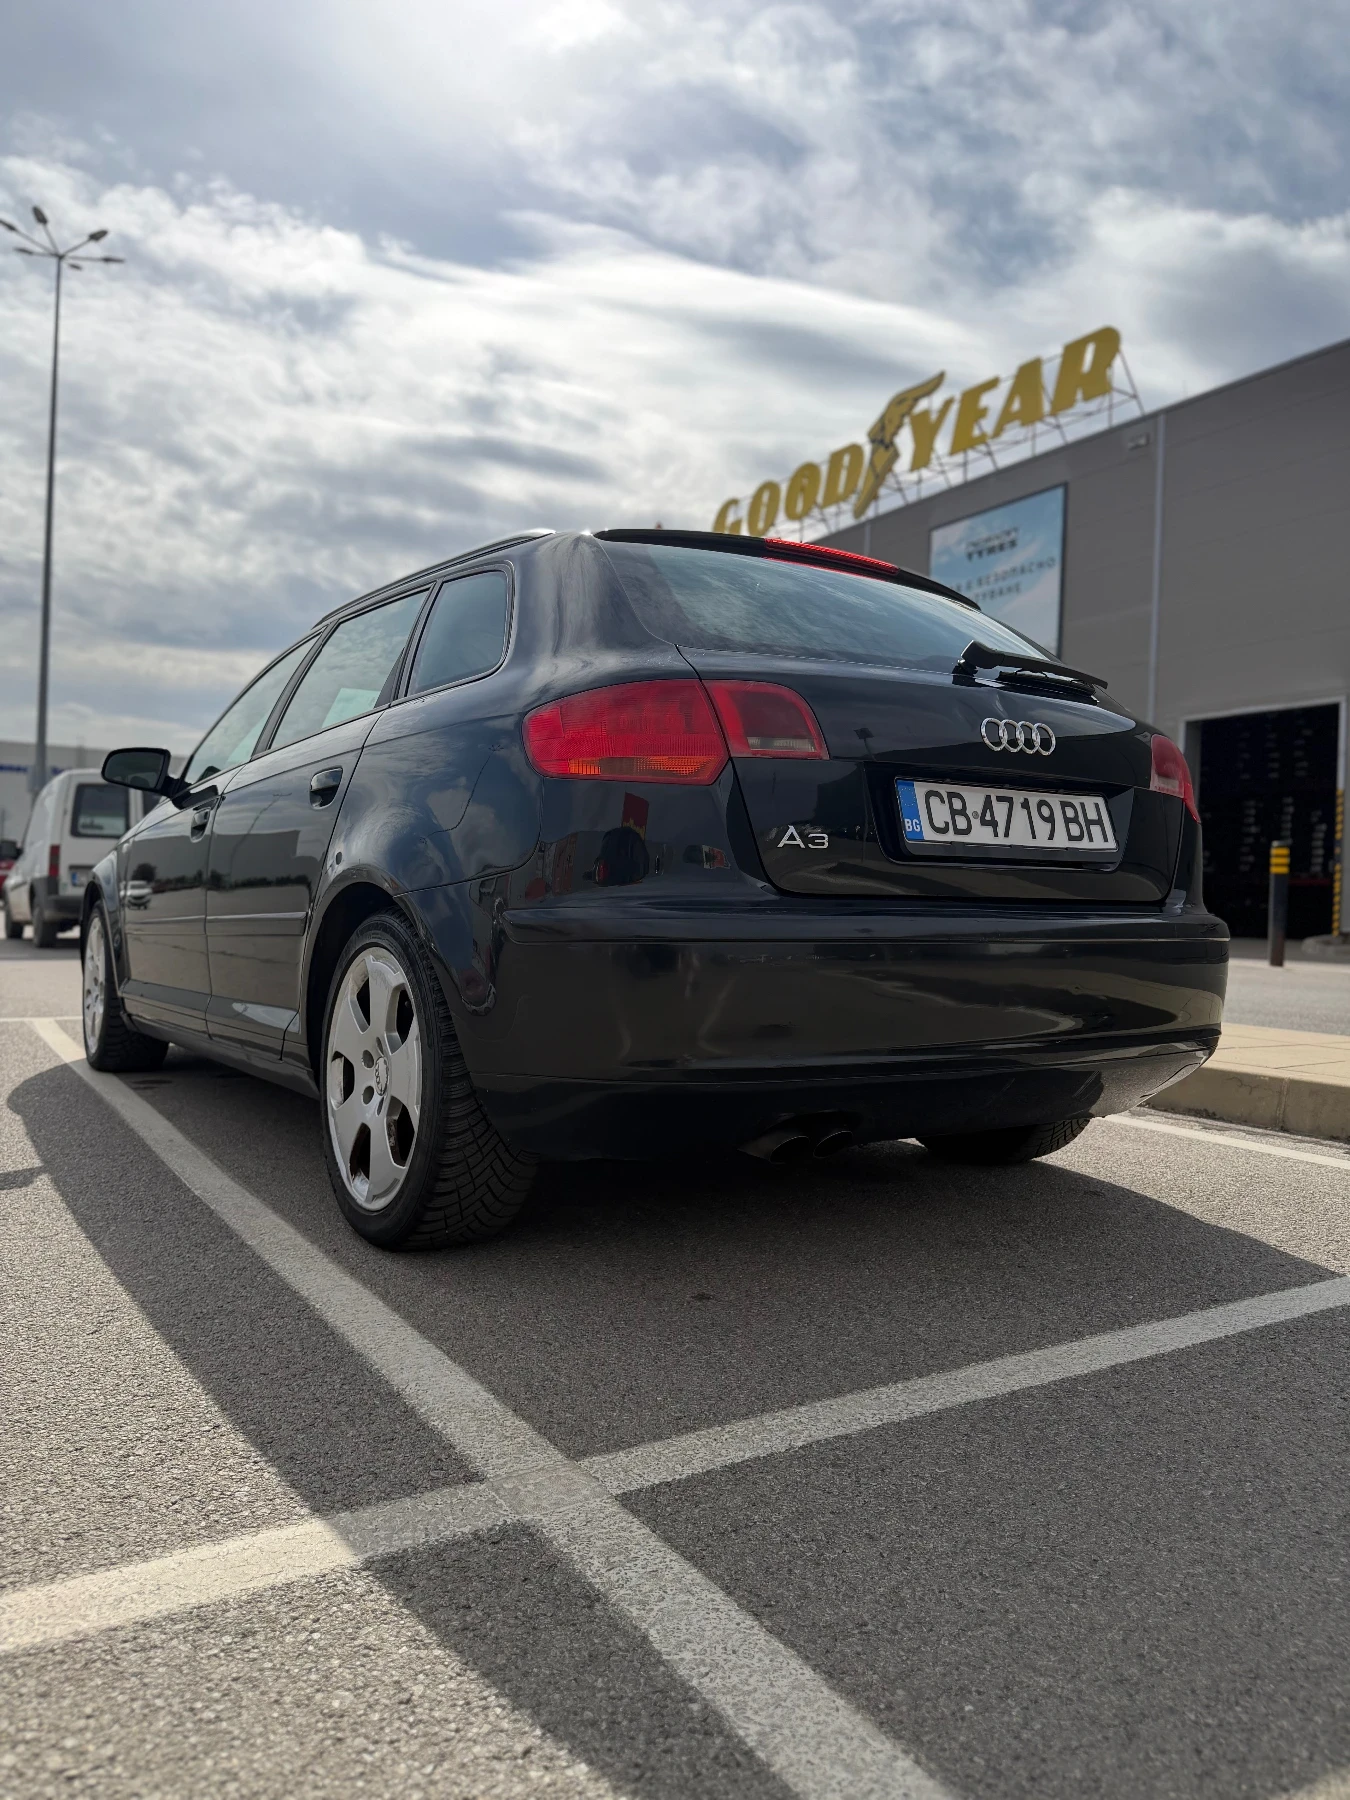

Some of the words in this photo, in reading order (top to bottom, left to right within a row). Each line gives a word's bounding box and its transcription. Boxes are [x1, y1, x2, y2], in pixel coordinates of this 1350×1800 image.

[713, 325, 1121, 537] GOODYEAR
[905, 818, 921, 833] BG
[924, 790, 973, 836] CB
[979, 794, 1056, 841] 4719
[1060, 800, 1109, 843] BH
[777, 825, 829, 849] A3
